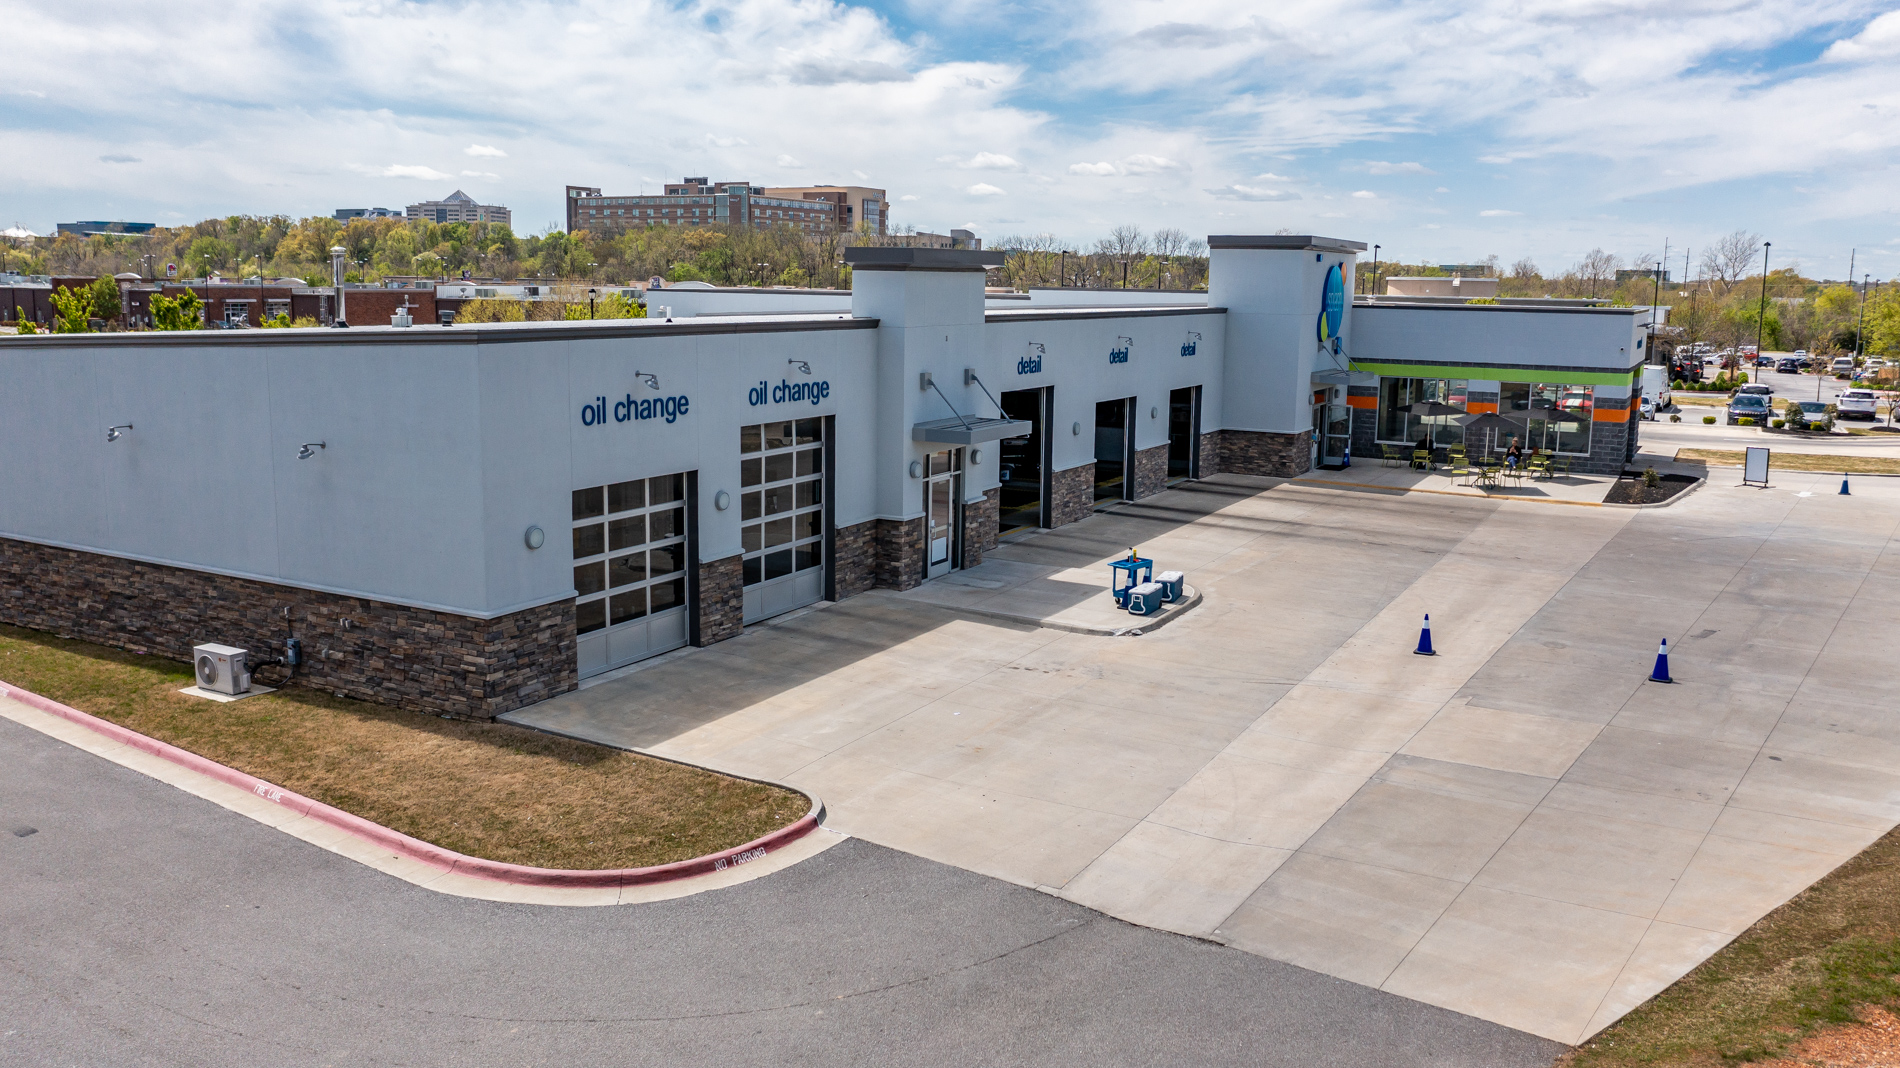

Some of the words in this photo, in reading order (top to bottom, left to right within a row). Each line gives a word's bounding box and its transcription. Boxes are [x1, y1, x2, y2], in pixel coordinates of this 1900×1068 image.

[1109, 347, 1128, 364] detail
[1180, 341, 1196, 357] detail
[1017, 355, 1042, 375] detail
[748, 380, 767, 406] oil
[772, 379, 830, 405] change
[581, 396, 606, 426] oil
[614, 393, 689, 424] change
[253, 783, 269, 796] FIRE
[267, 789, 284, 802] LANE
[714, 858, 728, 872] NO
[731, 846, 767, 866] PARKING
